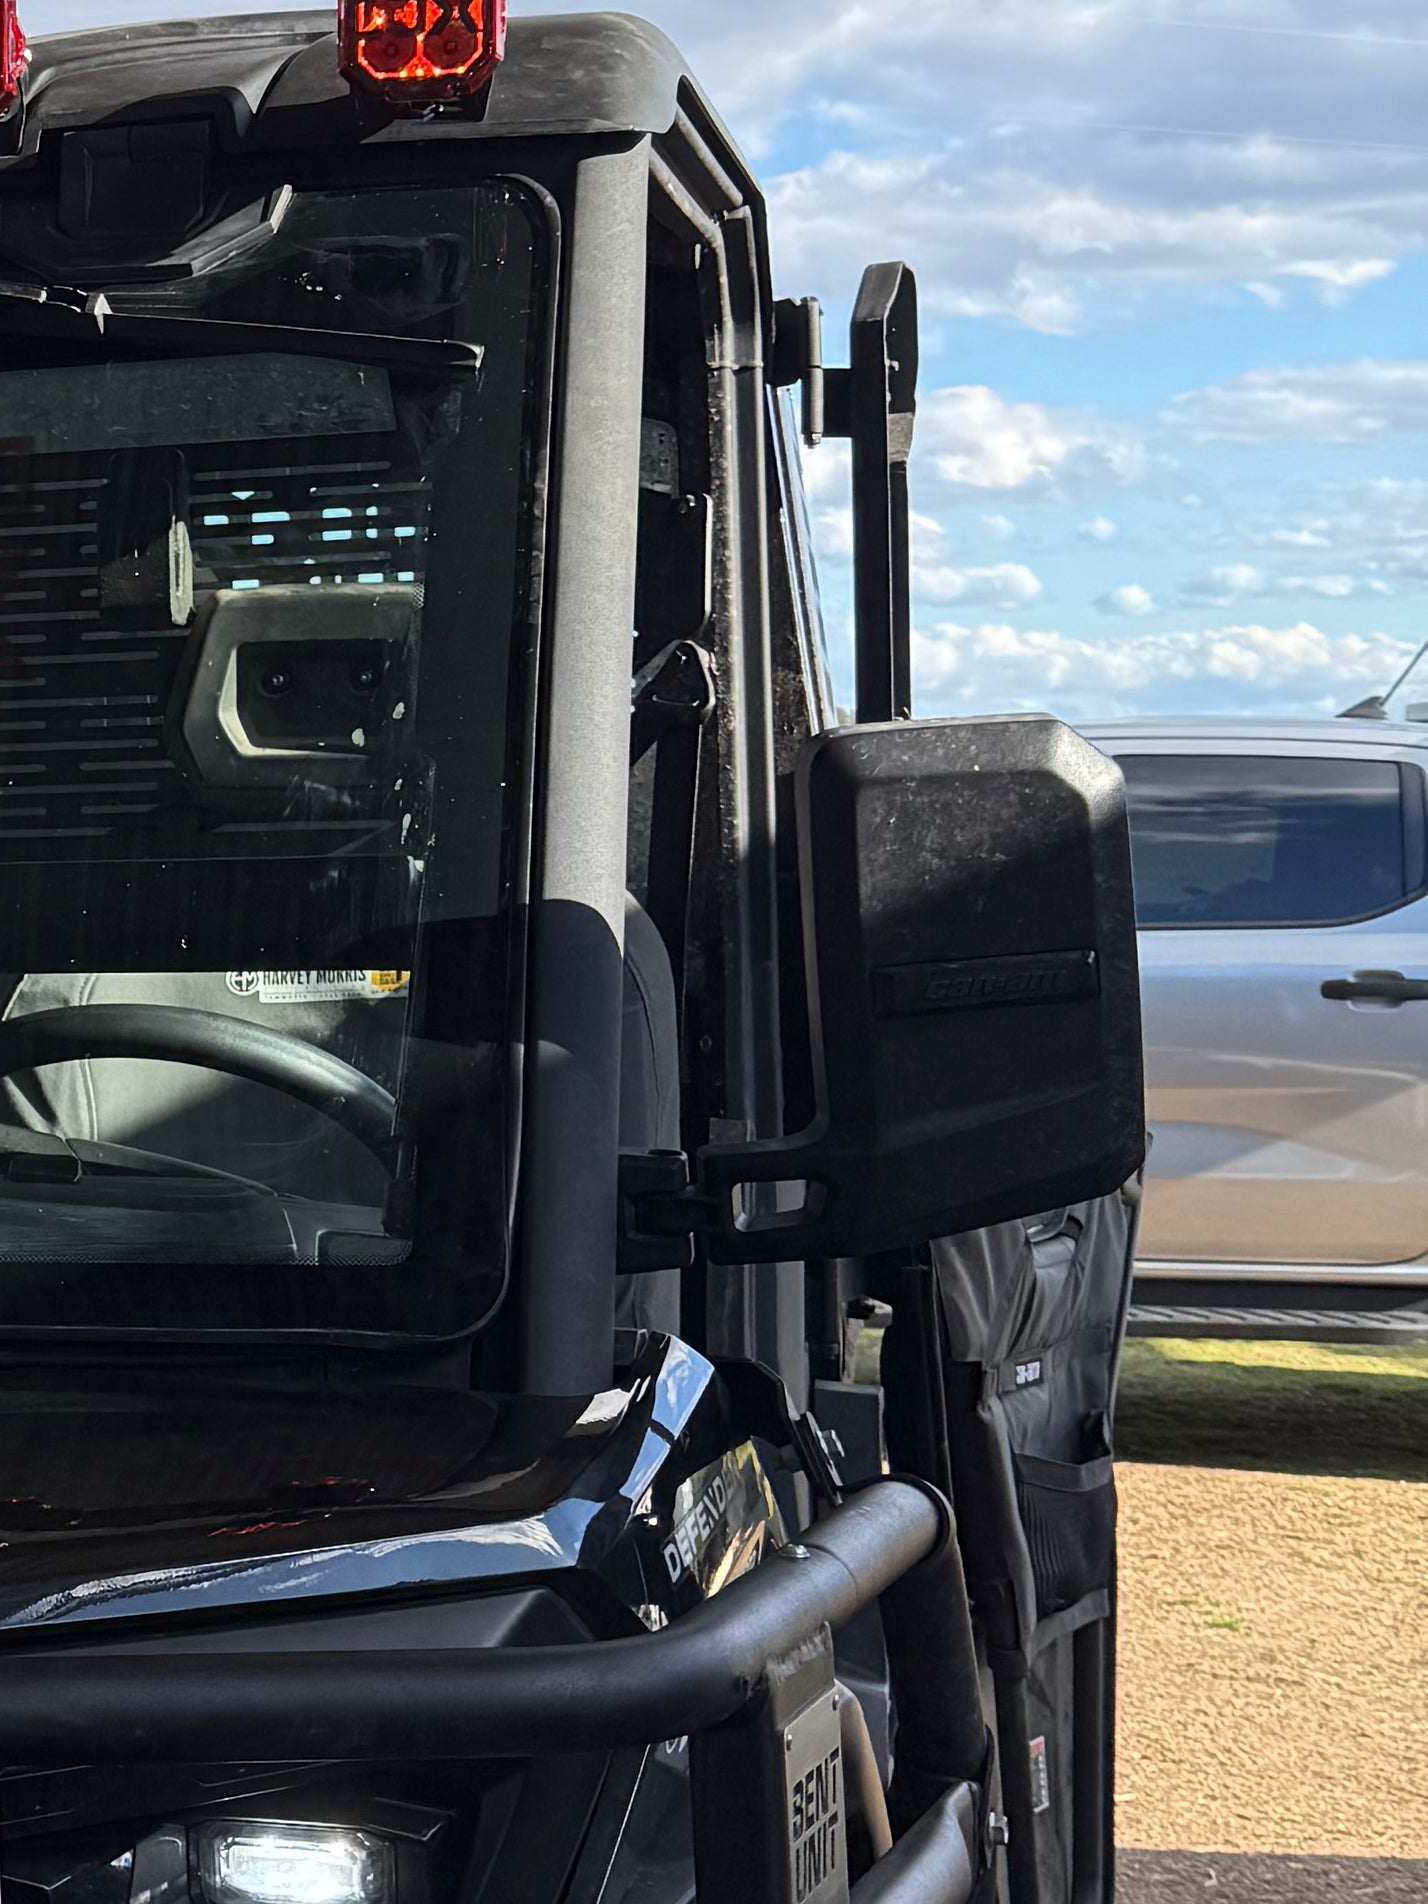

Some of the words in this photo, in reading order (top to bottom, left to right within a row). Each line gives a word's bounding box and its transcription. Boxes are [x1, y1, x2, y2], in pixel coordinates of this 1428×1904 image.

[263, 971, 311, 986] HARVEY
[792, 1747, 840, 1843] BENT
[796, 1811, 839, 1904] UNIT
